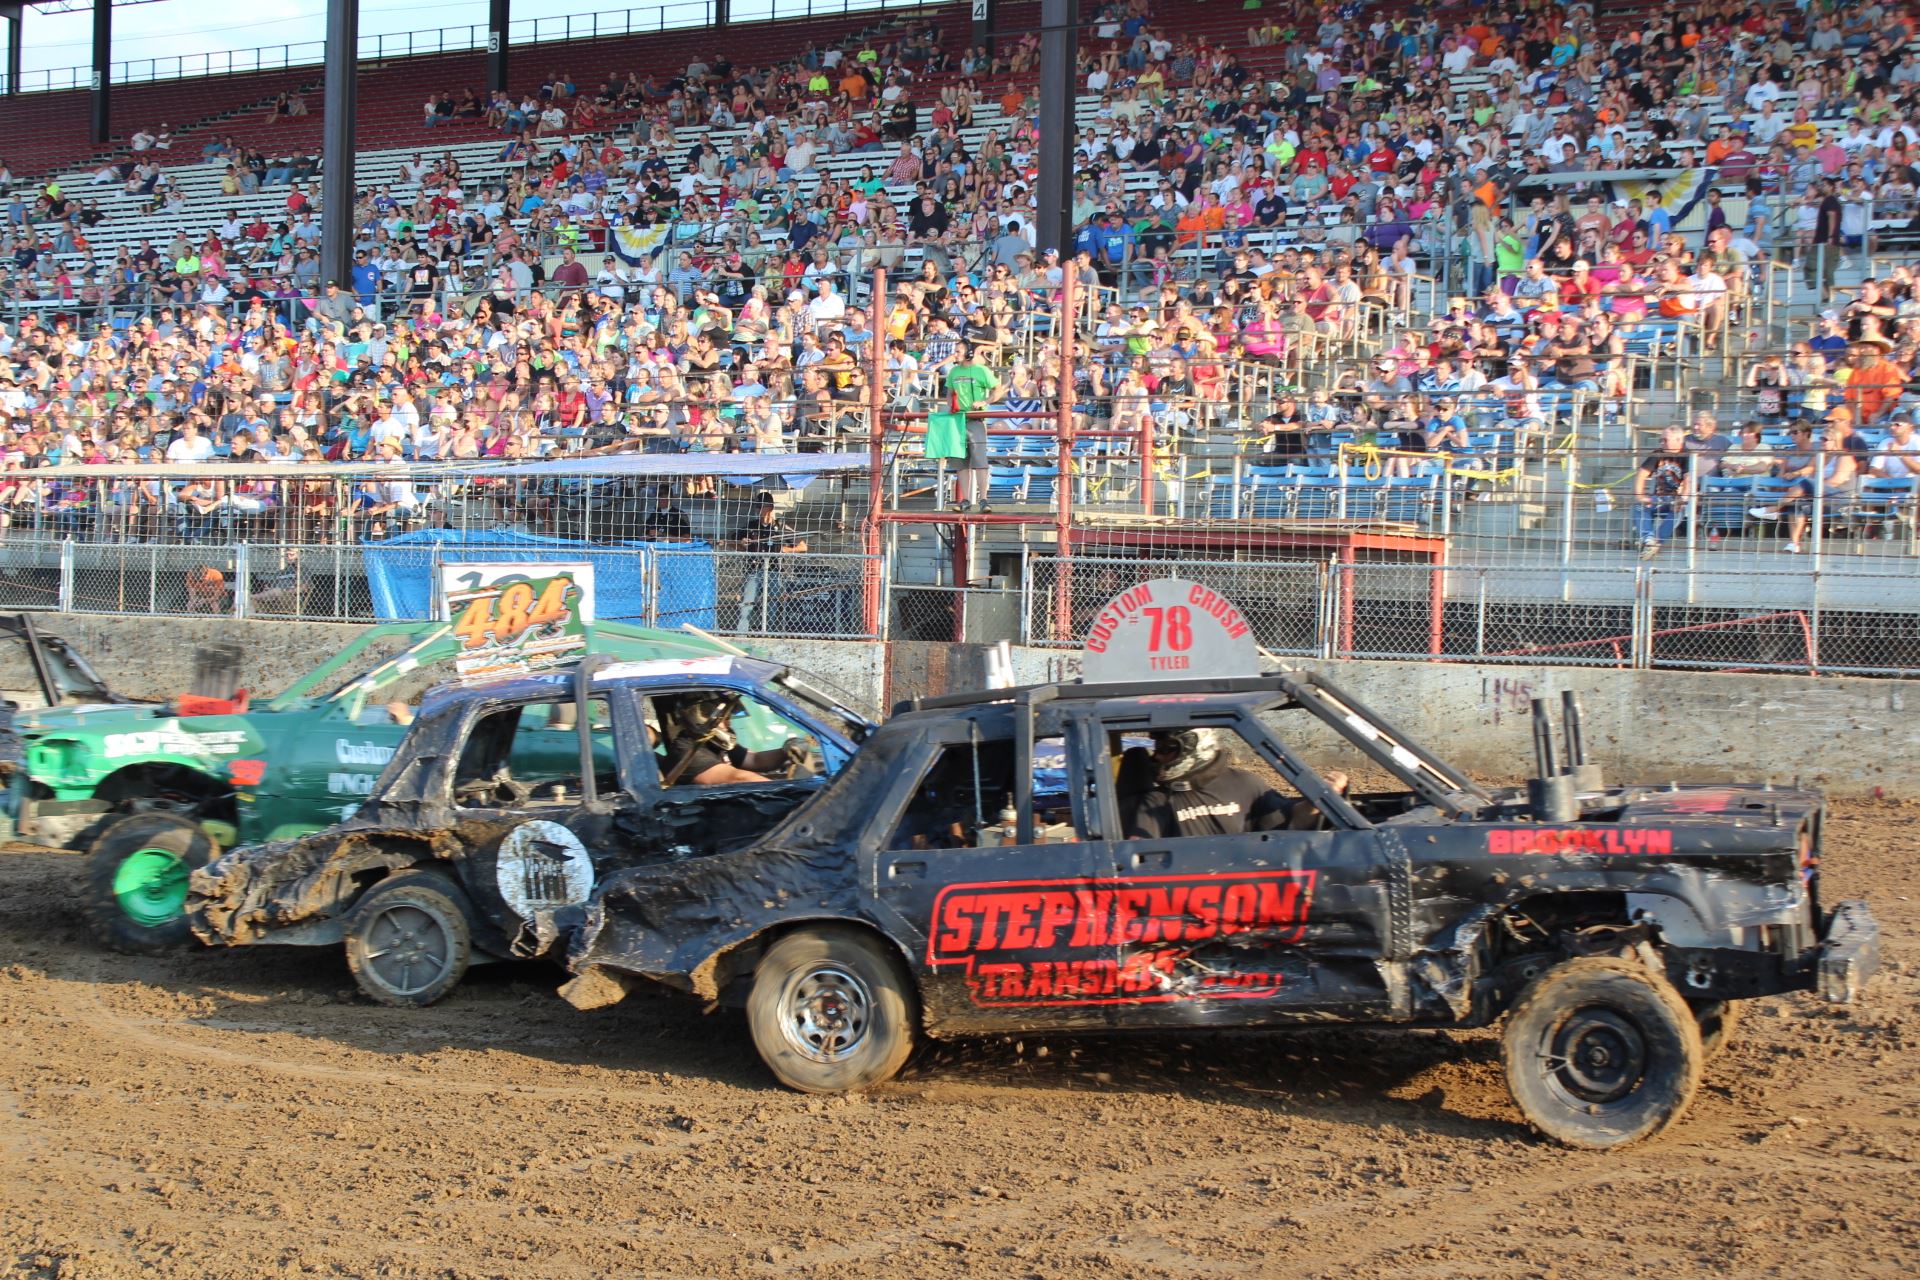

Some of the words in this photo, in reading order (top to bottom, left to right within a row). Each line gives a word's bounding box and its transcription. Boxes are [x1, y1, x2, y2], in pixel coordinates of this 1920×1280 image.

[974, 3, 985, 18] 4
[489, 37, 498, 51] 3
[92, 76, 99, 89] 2
[454, 576, 572, 650] 484
[1087, 584, 1154, 653] CUSTOM
[1188, 584, 1249, 640] CRUSH
[1149, 655, 1190, 671] TYLER
[1488, 829, 1672, 854] BROOKLYN
[940, 882, 1308, 952] STEPHENSON
